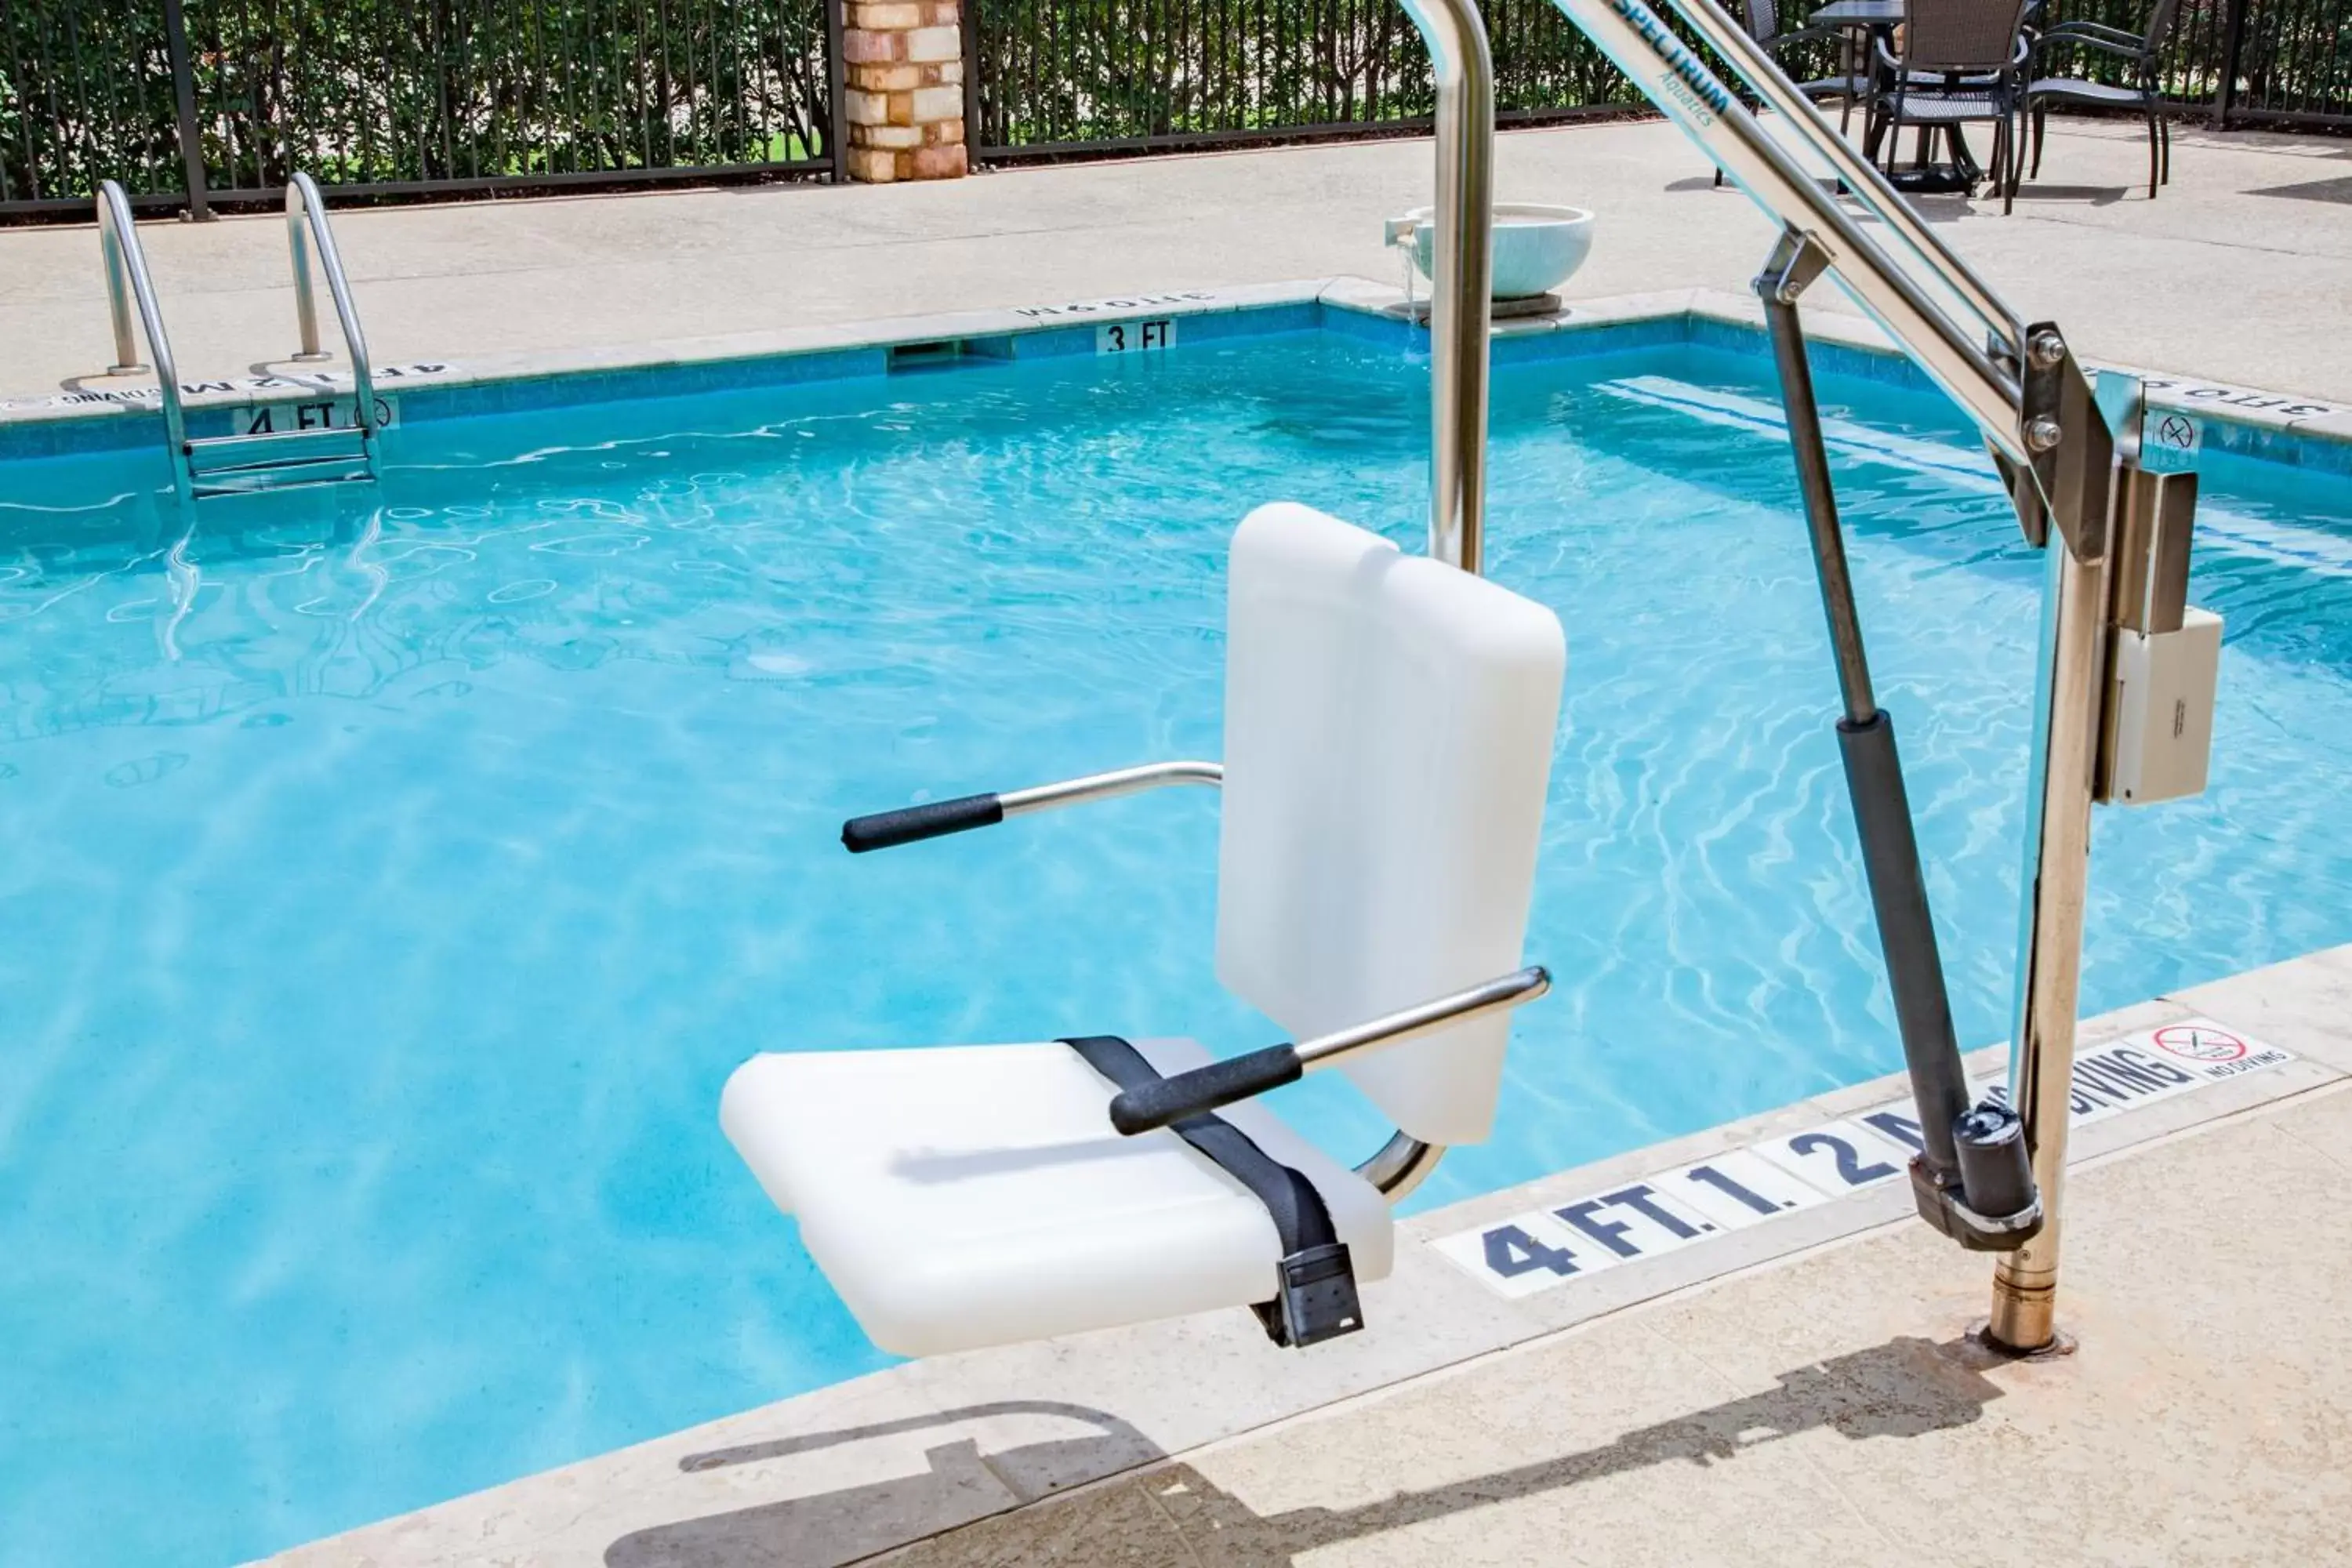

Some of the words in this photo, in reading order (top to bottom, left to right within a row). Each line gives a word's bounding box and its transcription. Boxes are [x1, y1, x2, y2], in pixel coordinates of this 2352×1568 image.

[1656, 71, 1715, 127] Aquatics
[1107, 325, 1126, 353] 3
[1142, 320, 1171, 350] FT
[413, 364, 445, 372] 4
[62, 388, 147, 404] DIVING
[180, 381, 236, 395] M
[248, 408, 275, 435] 4
[296, 401, 336, 430] FT
[2205, 1065, 2235, 1078] NO
[2228, 1051, 2288, 1072] DIVING
[1482, 1224, 1581, 1279] 4
[1552, 1184, 1717, 1259] FT.
